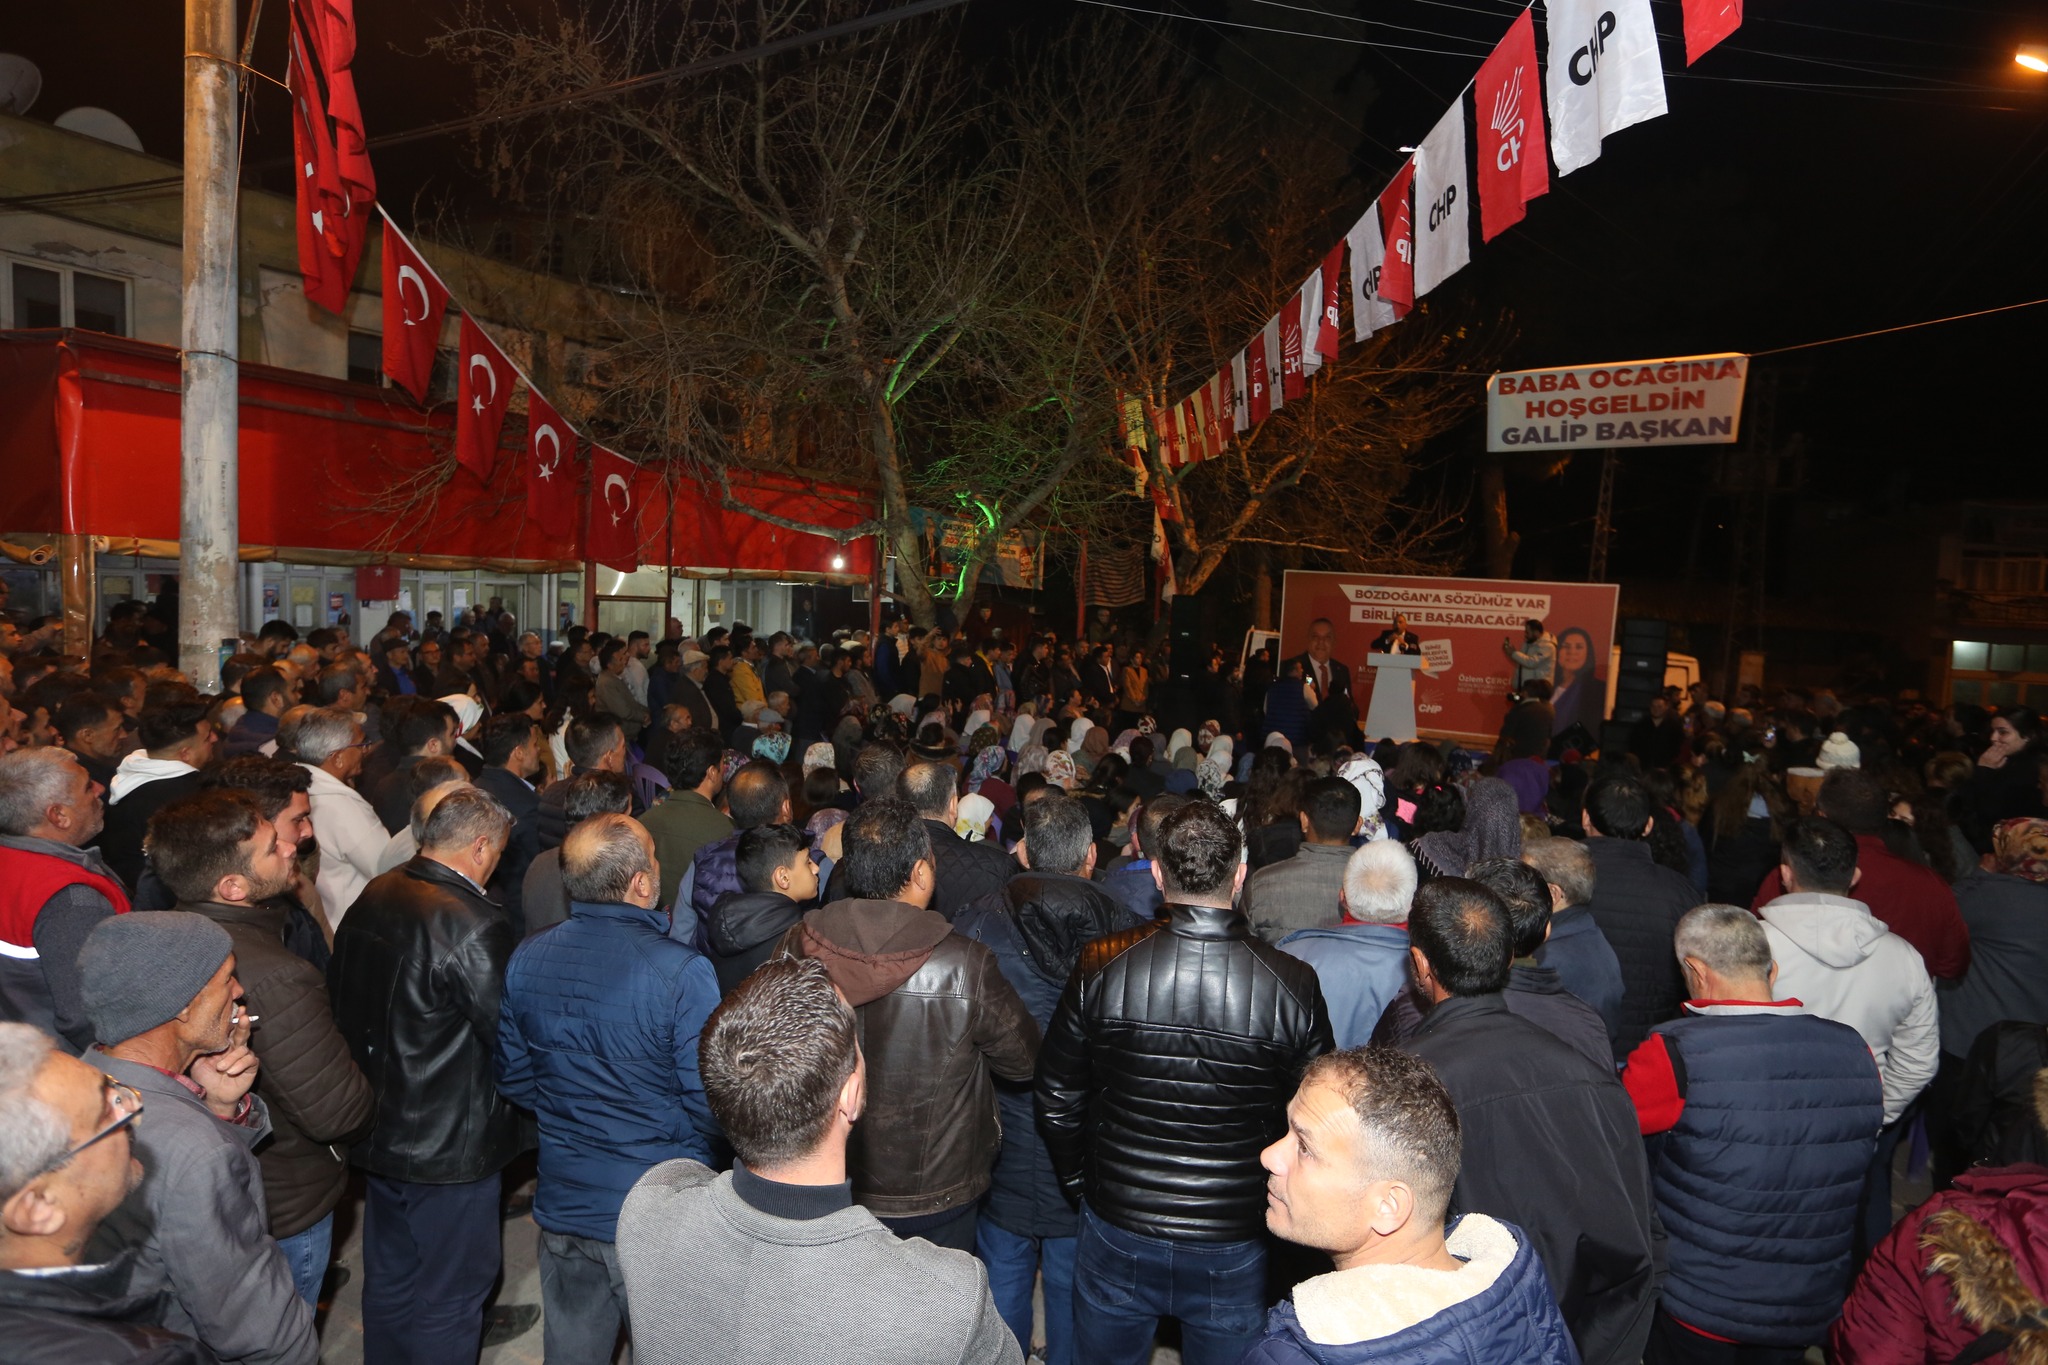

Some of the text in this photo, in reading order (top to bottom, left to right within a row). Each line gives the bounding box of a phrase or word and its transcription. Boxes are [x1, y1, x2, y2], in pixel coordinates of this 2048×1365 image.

[1568, 11, 1616, 86] CHP
[1497, 132, 1522, 172] CH
[1429, 184, 1457, 232] CHP
[1285, 355, 1301, 374] CH
[1498, 360, 1742, 395] BABA OCAĞINA
[1525, 387, 1705, 420] HOŞGELDİN
[1501, 416, 1732, 445] GALİP BAŞKAN
[1355, 589, 1545, 609] BOZDOĞAN'A SÖZÜMÜZ VAR
[1426, 612, 1529, 627] BAŞARACAĞIZ
[1418, 704, 1442, 713] CHP
